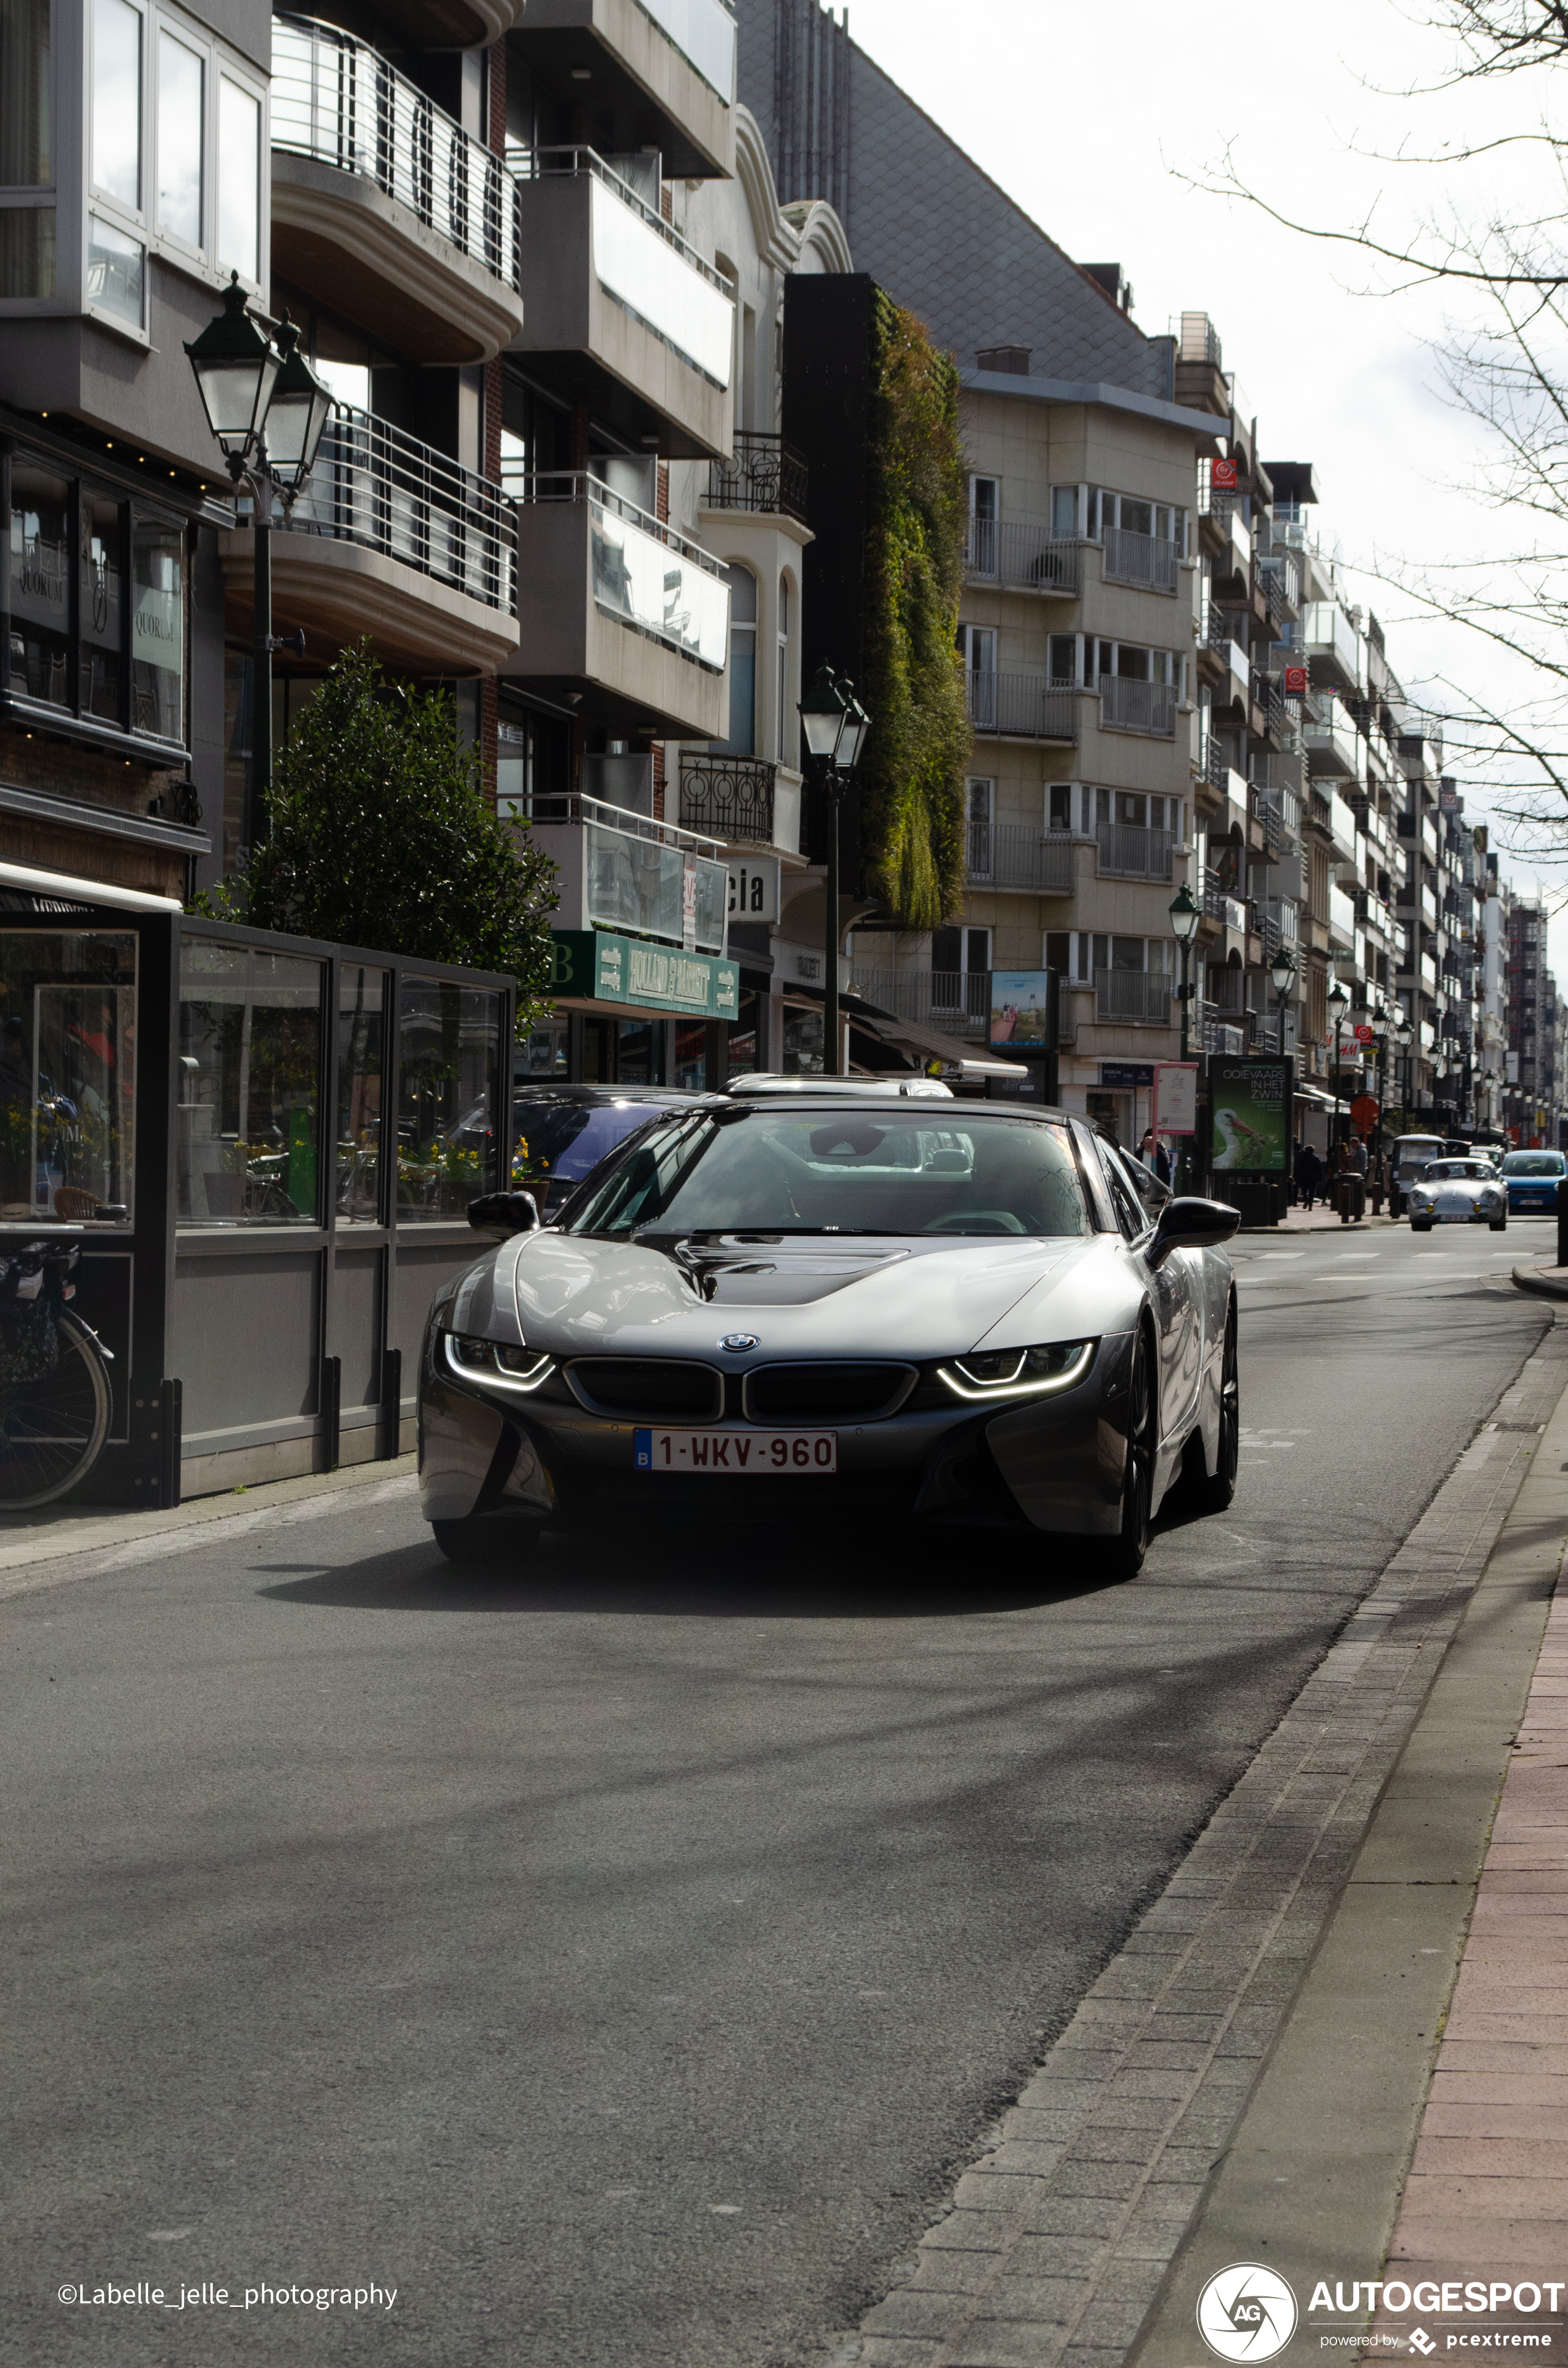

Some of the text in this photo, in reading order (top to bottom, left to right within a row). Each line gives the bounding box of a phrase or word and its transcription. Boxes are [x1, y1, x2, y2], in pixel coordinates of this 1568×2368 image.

[19, 566, 62, 603] QUORUM
[136, 610, 173, 643] QUORUM
[1340, 1044, 1358, 1056] H&M
[1223, 1069, 1285, 1079] OOIEVAARS
[1251, 1080, 1285, 1089] IN HET
[1251, 1089, 1283, 1098] ZWIN
[638, 1436, 832, 1467] B 1-WKV-960
